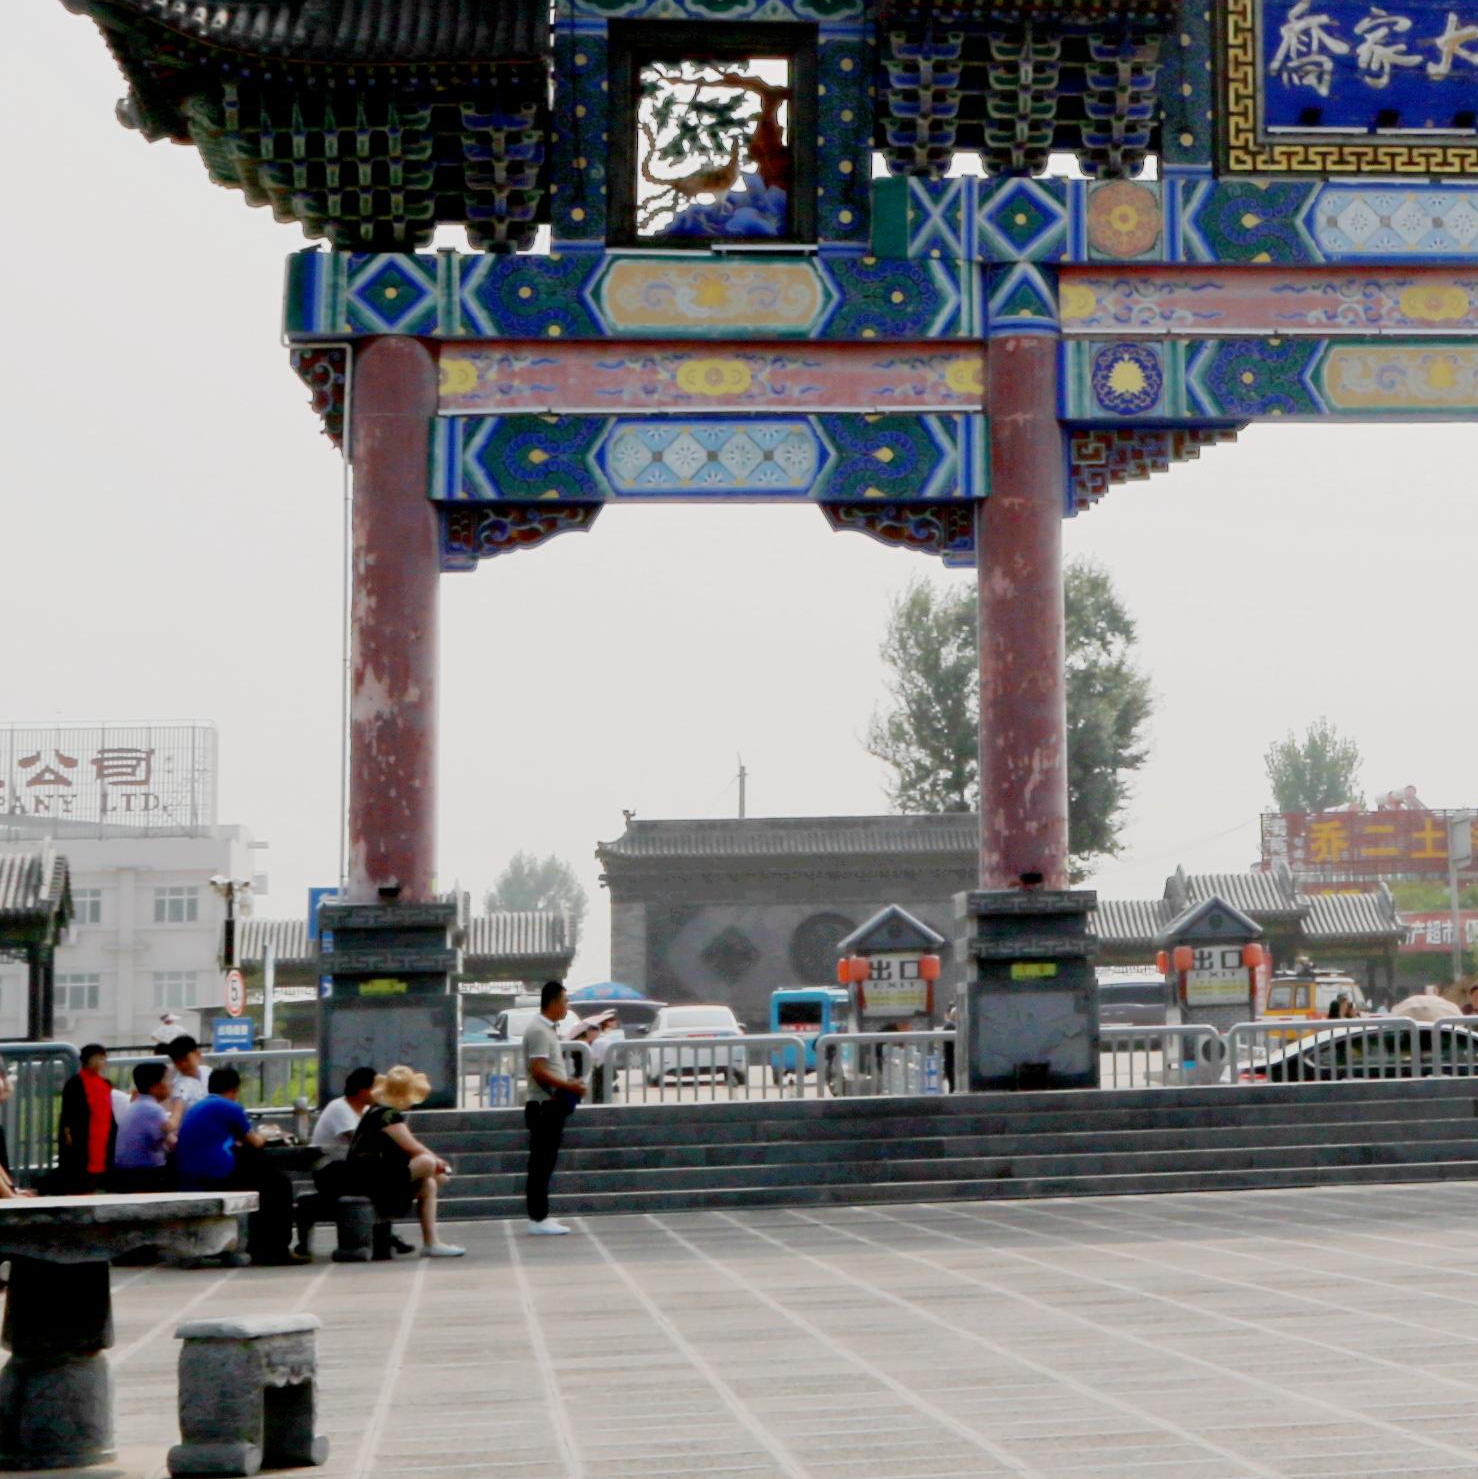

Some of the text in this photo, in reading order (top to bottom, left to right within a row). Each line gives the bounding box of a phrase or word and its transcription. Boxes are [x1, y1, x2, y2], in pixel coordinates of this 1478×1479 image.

[0, 748, 156, 787] 公司
[1399, 919, 1455, 946] 产超市
[868, 959, 920, 980] 出口
[1192, 949, 1243, 970] 出口
[231, 979, 239, 1002] 5
